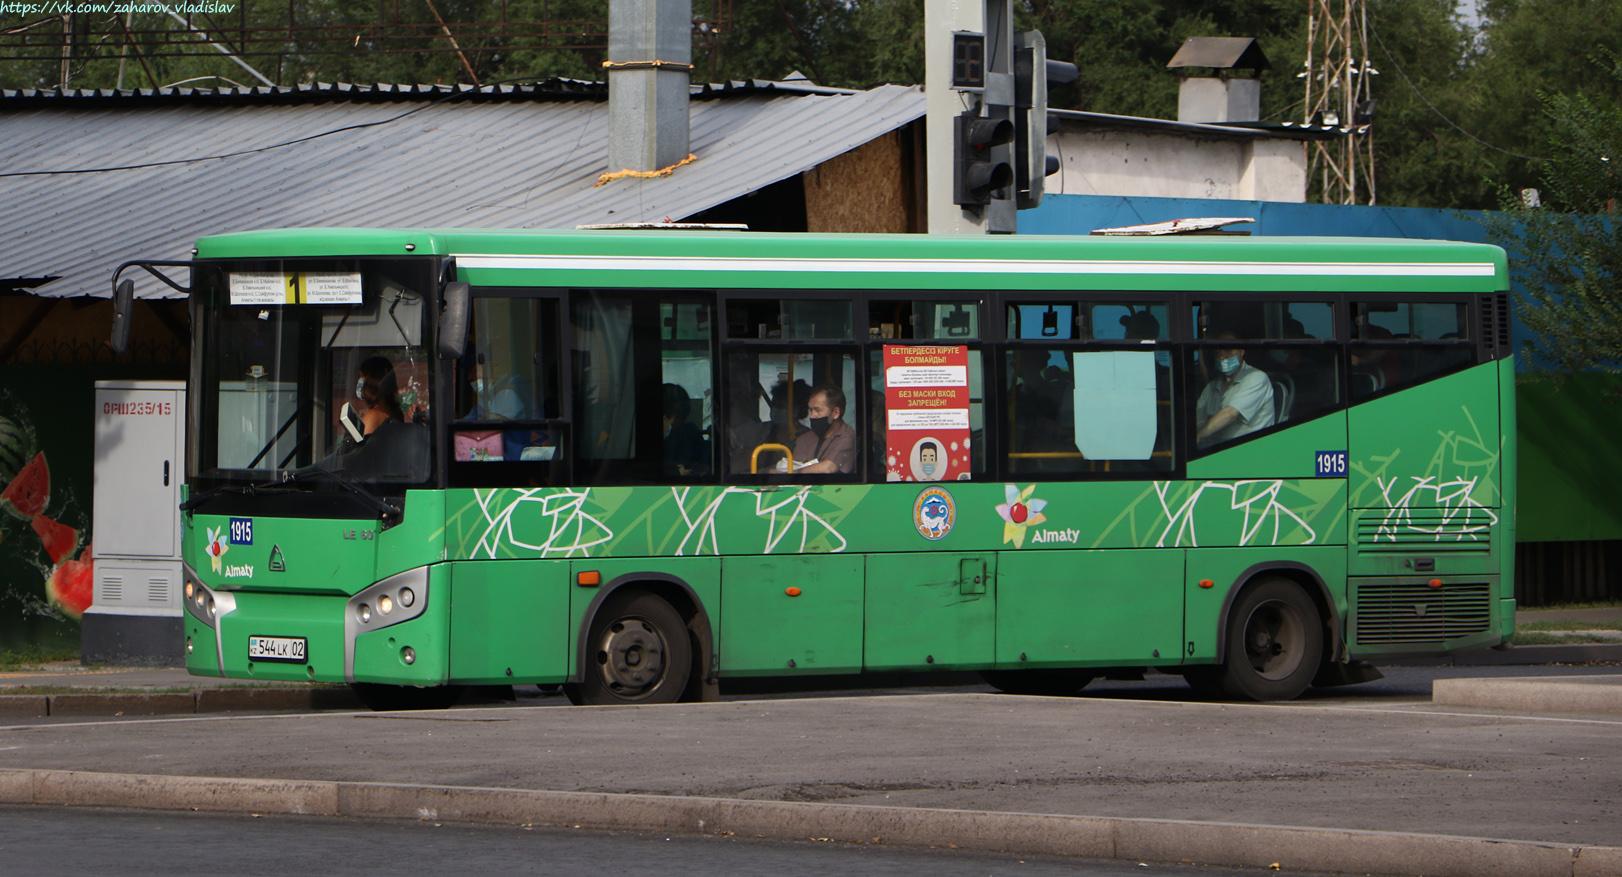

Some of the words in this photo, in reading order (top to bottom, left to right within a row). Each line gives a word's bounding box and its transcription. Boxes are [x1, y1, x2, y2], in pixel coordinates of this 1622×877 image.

[289, 272, 300, 304] 1
[890, 347, 936, 355] БЕТПЕРДЕСІЗ
[937, 346, 960, 355] КІРУГЕ
[904, 355, 947, 364] БОЛМАЙДЫ!
[898, 390, 912, 398] БЕЗ
[937, 390, 956, 398] ВХОД
[907, 398, 947, 407] ЗАПРЕЩЁН!
[1317, 454, 1345, 473] 1915
[230, 521, 252, 542] 1915
[343, 529, 356, 540] LE
[361, 529, 374, 540] 60
[1031, 528, 1080, 544] Almaty
[224, 564, 254, 579] Almaty
[259, 640, 276, 656] 544
[277, 644, 288, 656] LK
[292, 641, 304, 657] 02
